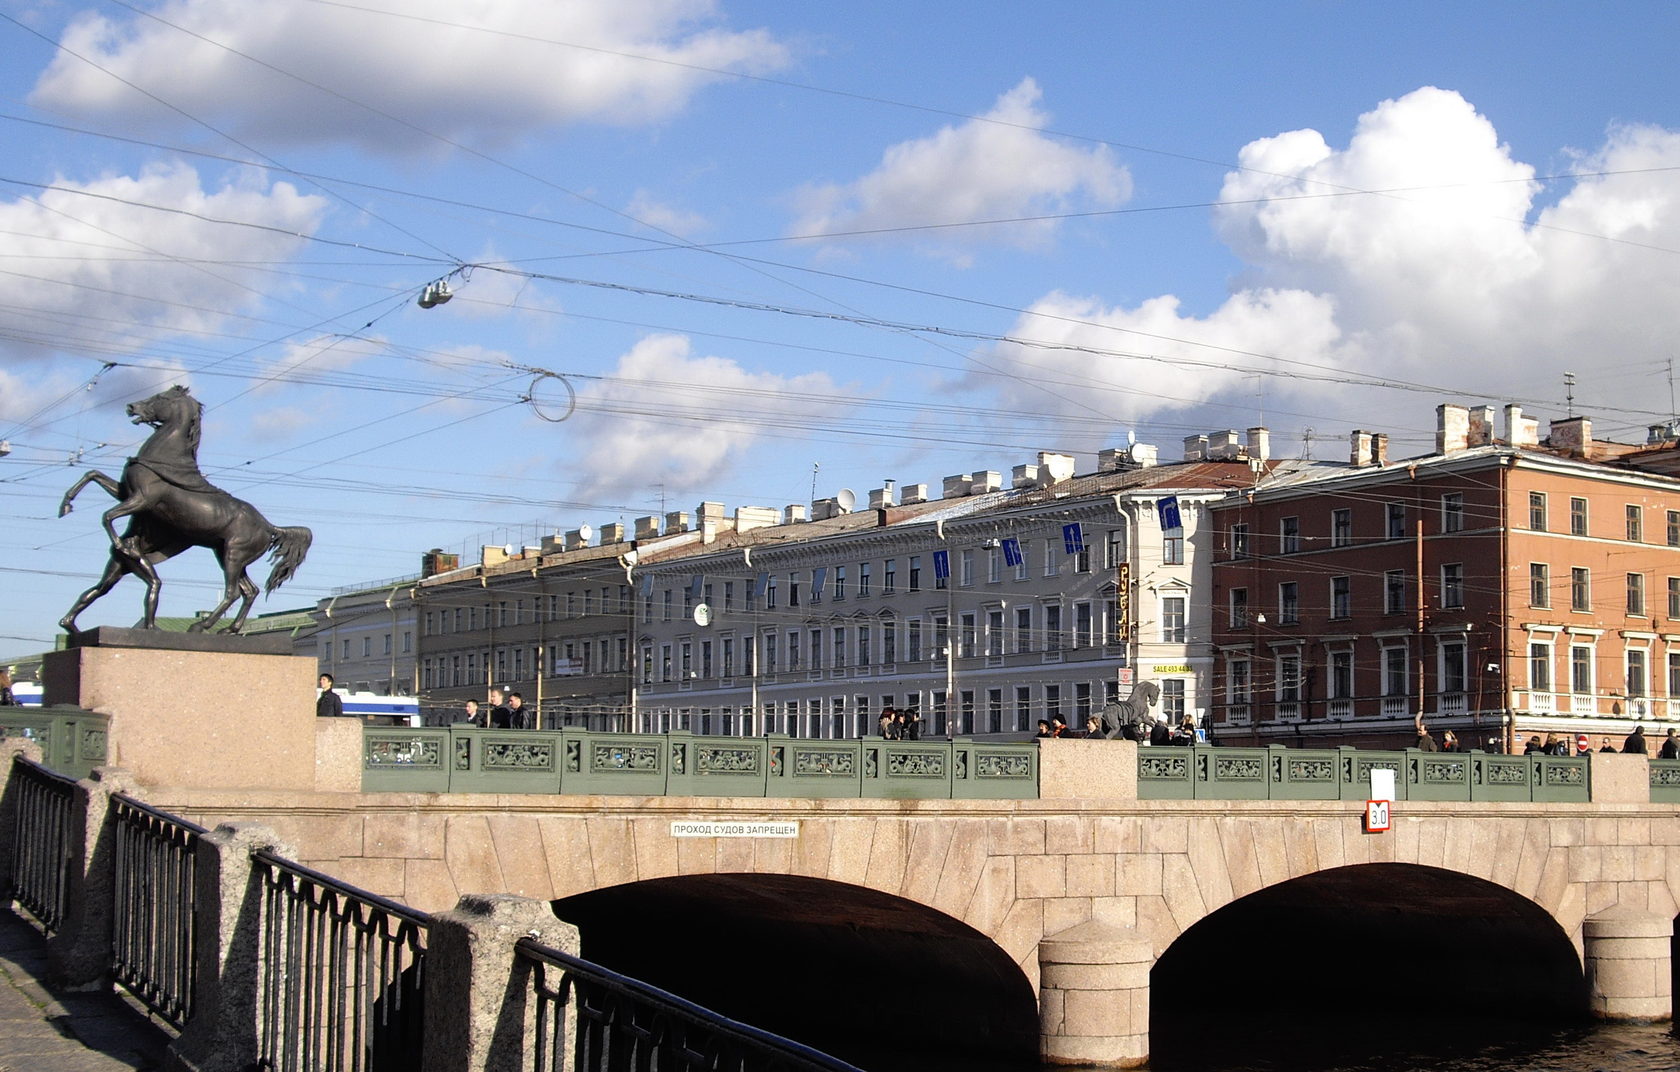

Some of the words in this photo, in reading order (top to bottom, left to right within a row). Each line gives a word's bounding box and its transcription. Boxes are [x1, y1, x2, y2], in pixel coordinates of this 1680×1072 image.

[1153, 665, 1167, 673] SALE
[674, 825, 712, 835] ПРОХОД
[714, 825, 744, 835] СУДОВ
[746, 825, 796, 836] ЗАПРЕЩЕН
